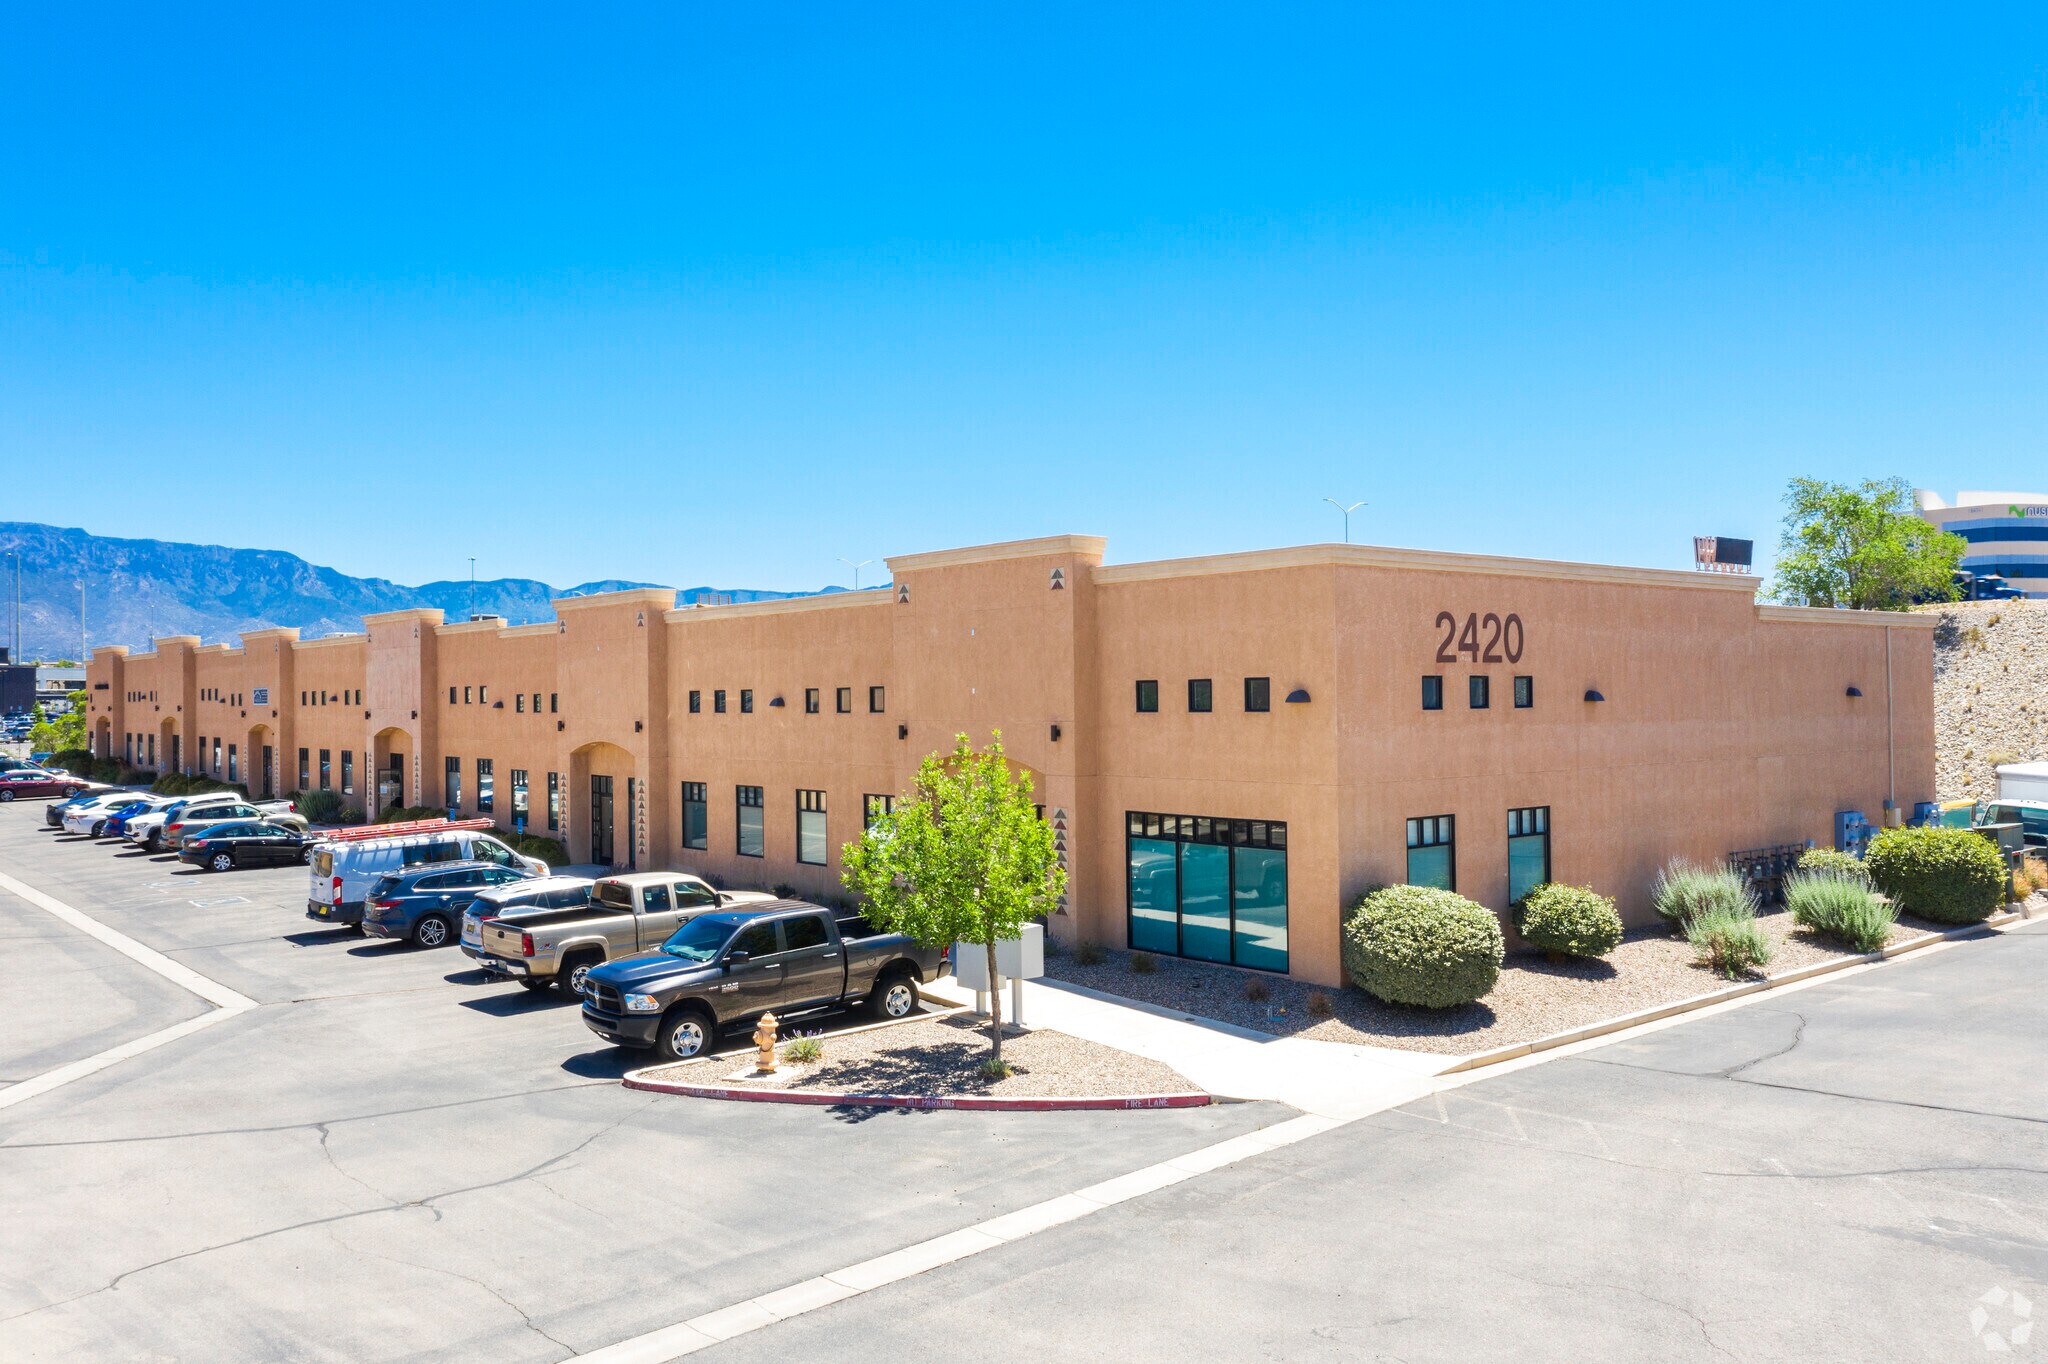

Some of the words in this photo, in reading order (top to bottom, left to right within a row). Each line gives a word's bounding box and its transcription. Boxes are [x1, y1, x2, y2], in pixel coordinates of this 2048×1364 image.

[2026, 506, 2048, 516] nus
[1435, 611, 1524, 664] 2420
[921, 1099, 955, 1108] PARKING
[1125, 1099, 1143, 1108] FIRE
[1147, 1097, 1169, 1107] LANE
